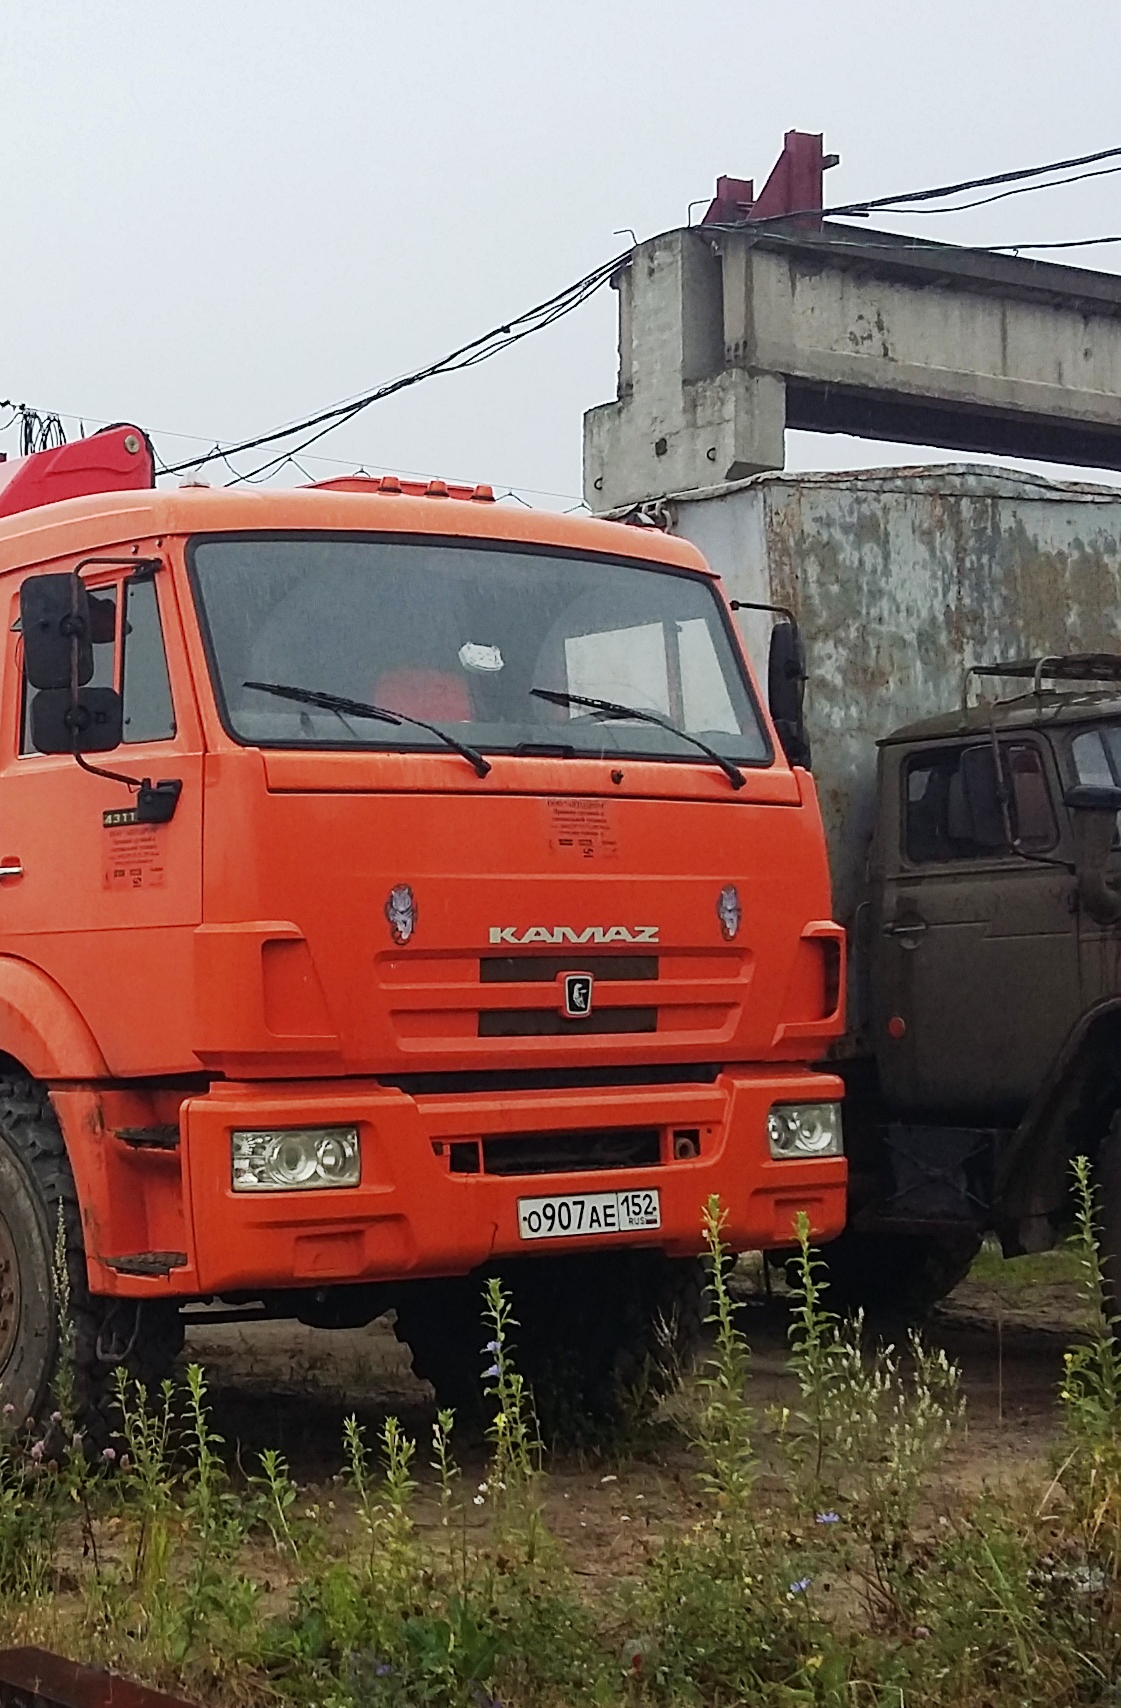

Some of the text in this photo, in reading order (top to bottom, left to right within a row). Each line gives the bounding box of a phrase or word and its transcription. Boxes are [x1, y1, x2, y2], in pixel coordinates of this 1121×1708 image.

[489, 926, 659, 943] KAMAZ
[621, 1193, 653, 1216] 152
[628, 1216, 645, 1225] RUS
